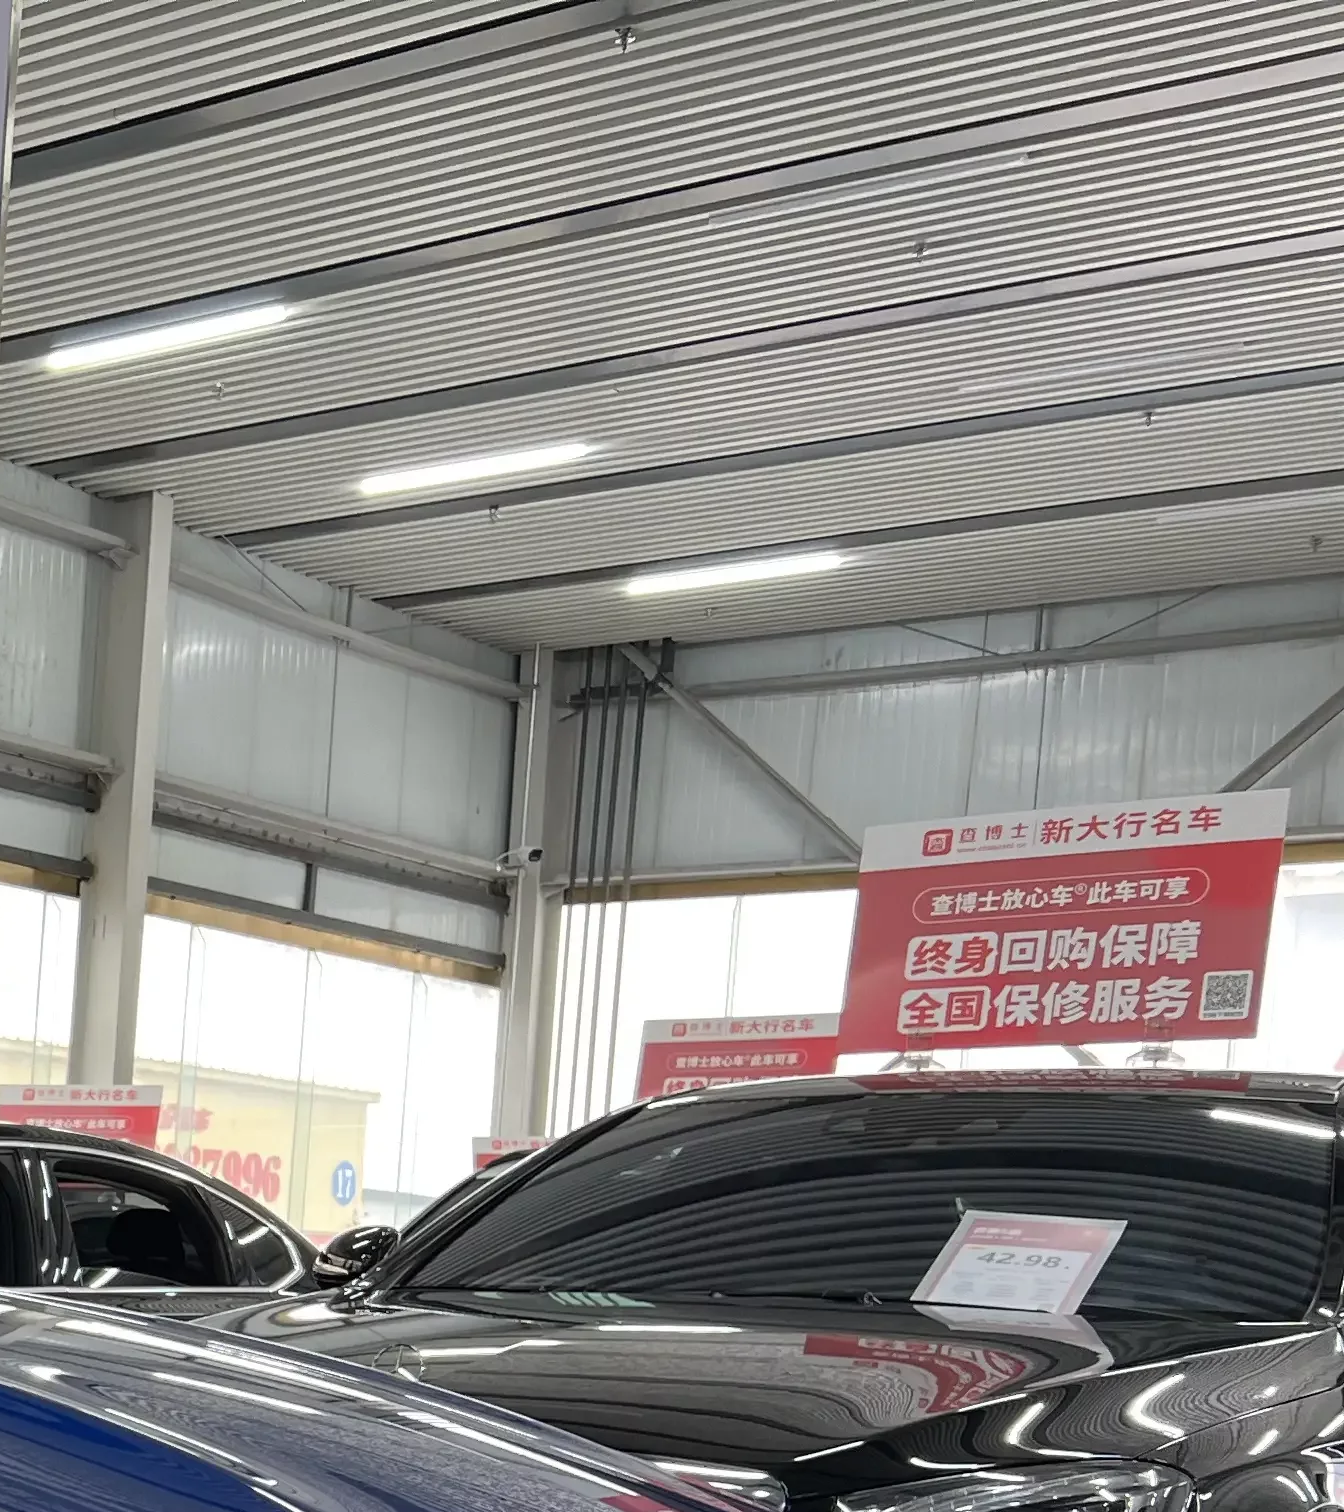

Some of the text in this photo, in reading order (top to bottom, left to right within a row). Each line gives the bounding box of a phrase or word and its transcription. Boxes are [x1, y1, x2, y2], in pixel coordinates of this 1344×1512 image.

[1040, 805, 1223, 845] 新大行名车
[911, 920, 1201, 976] 终身回购保障
[903, 976, 1194, 1028] 全国保修服务
[336, 1168, 353, 1199] 17
